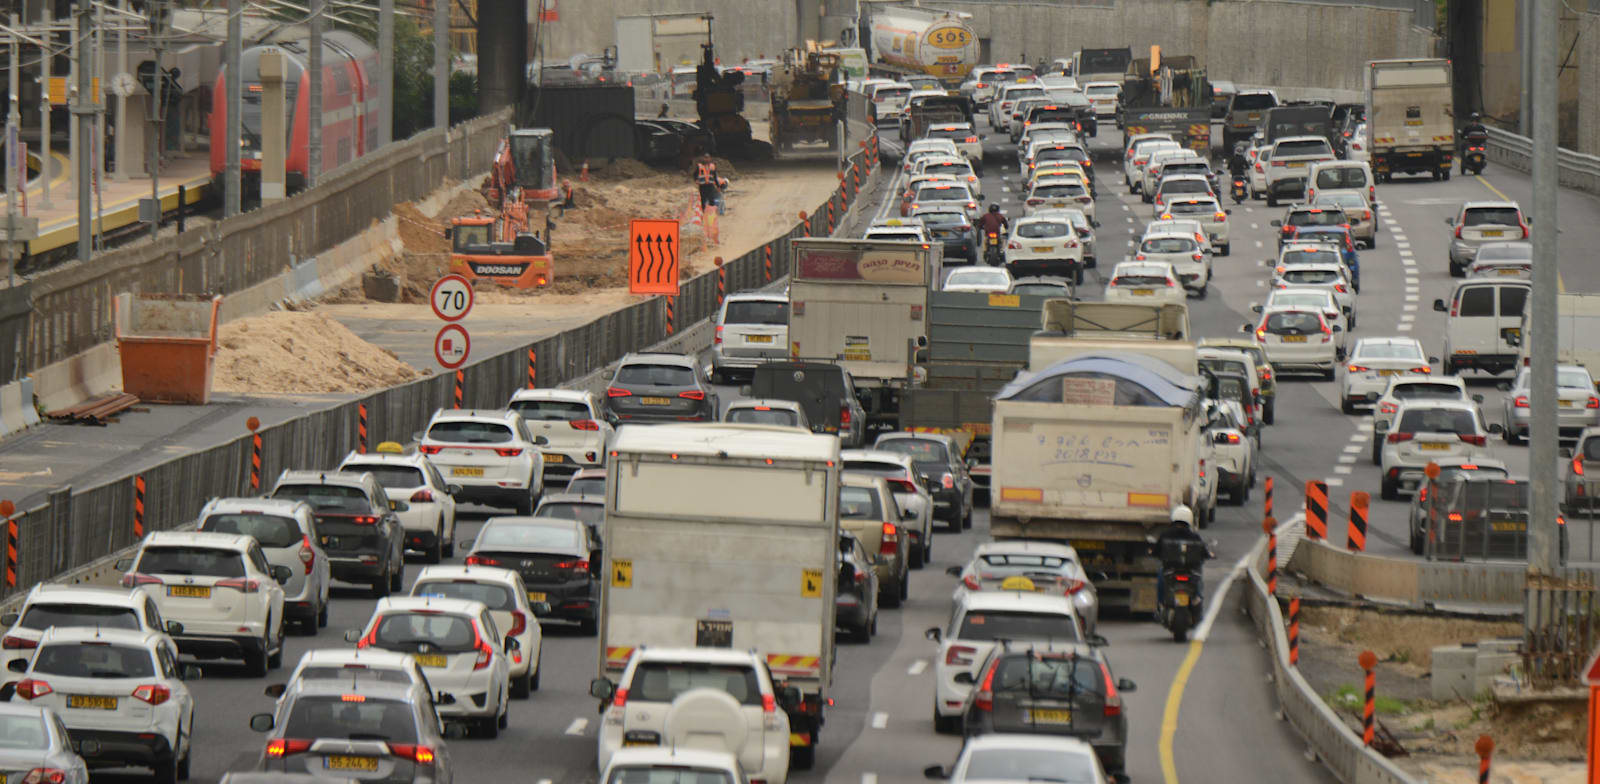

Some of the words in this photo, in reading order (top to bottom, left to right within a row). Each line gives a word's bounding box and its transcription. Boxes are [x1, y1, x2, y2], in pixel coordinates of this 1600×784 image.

[936, 32, 965, 44] SOS
[477, 265, 521, 275] DOOSAN
[441, 290, 465, 311] 70
